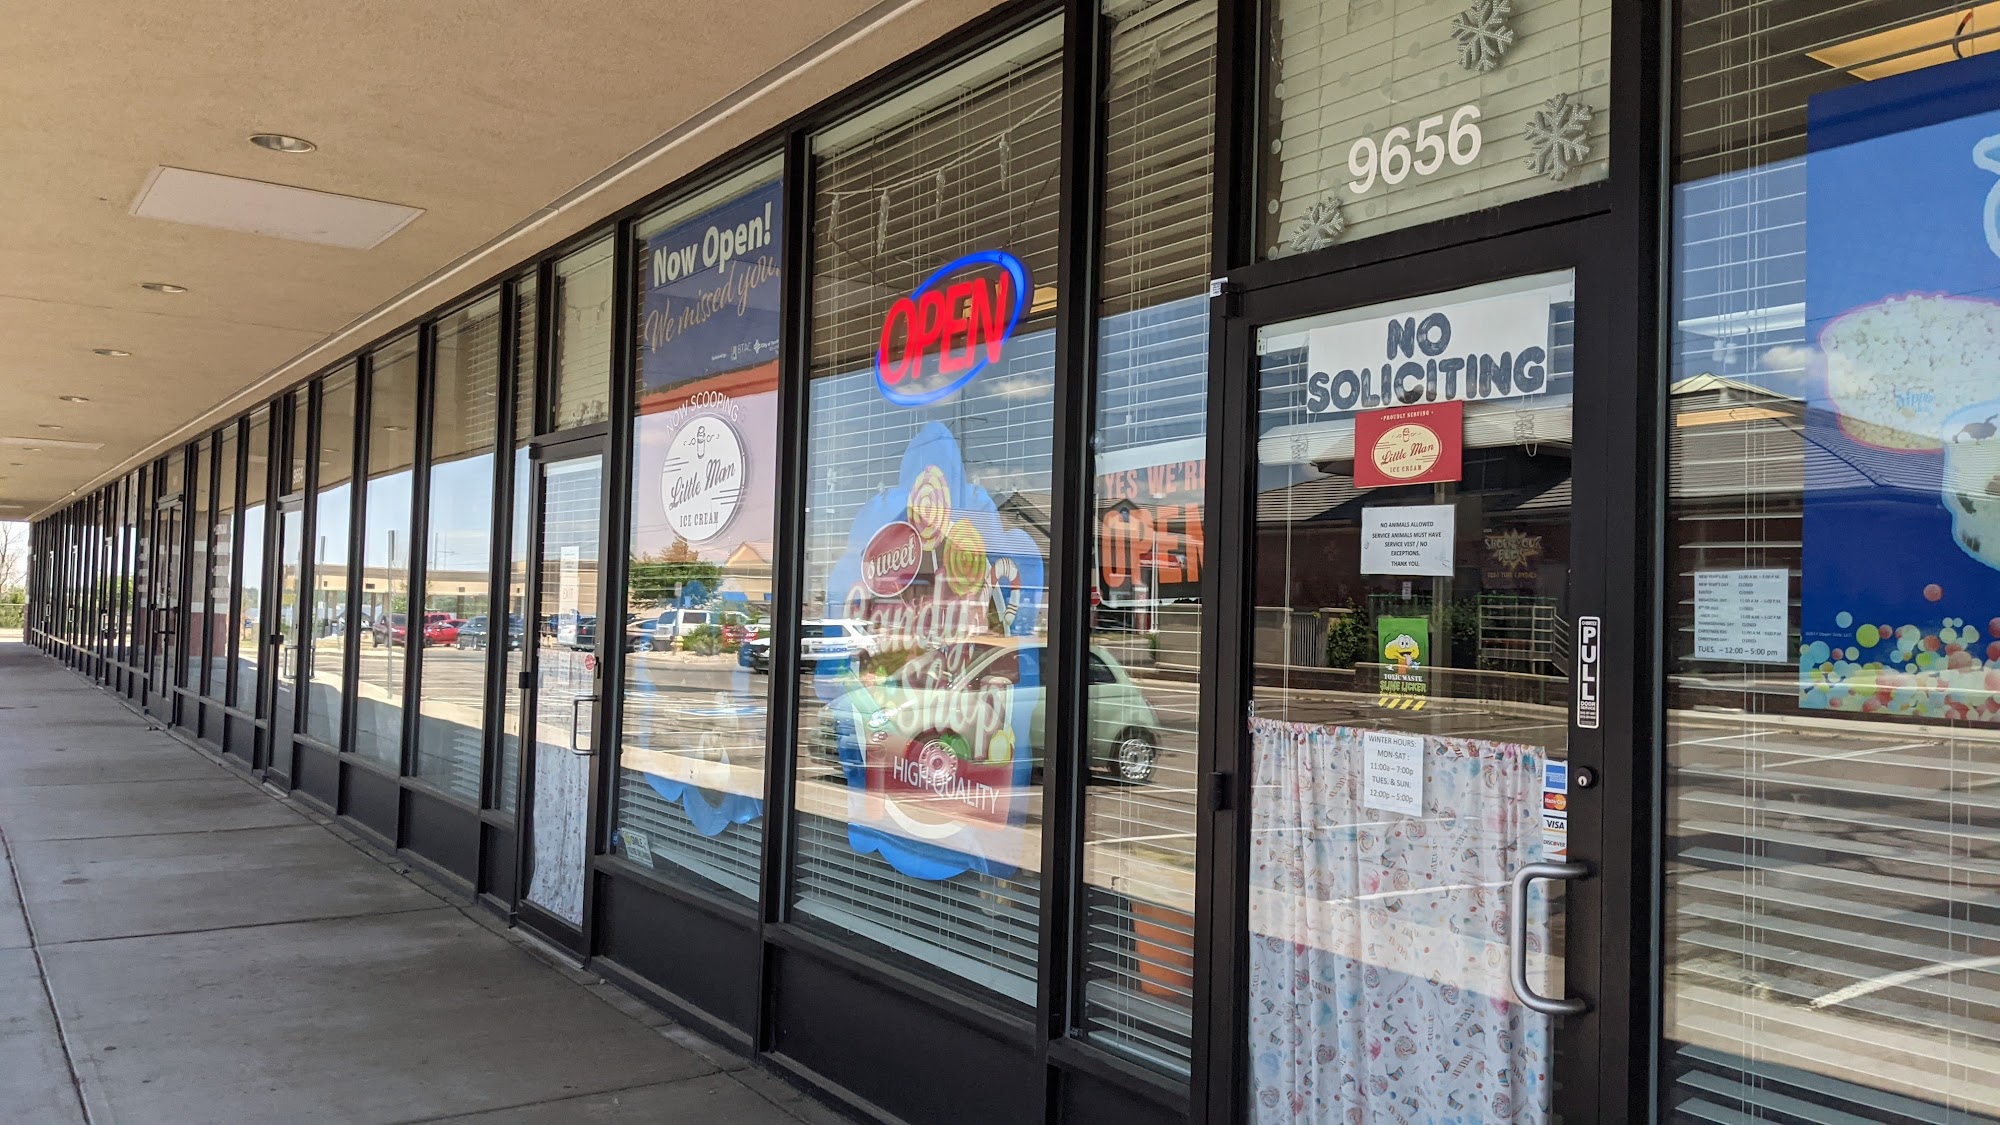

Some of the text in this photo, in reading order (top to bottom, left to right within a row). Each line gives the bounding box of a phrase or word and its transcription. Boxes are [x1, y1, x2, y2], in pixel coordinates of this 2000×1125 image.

[1348, 104, 1482, 194] 9656
[653, 201, 772, 288] Now Open!
[643, 298, 674, 354] We
[677, 260, 737, 336] missed
[879, 270, 1010, 386] OPEN
[1386, 312, 1452, 361] NO
[1306, 345, 1546, 414] SOLICITING
[665, 390, 740, 437] NOW SCOOPING
[1382, 410, 1430, 421] PROUDLY SERVING
[1380, 442, 1435, 466] Little Man
[1401, 464, 1422, 472] CREAM
[668, 458, 736, 511] Little Man
[1105, 468, 1138, 500] YES
[680, 511, 719, 528] ICE CREAM
[867, 533, 917, 580] sweet
[1101, 502, 1205, 588] OPEN
[843, 572, 974, 671] Candy
[1402, 674, 1423, 682] WASTE
[1581, 626, 1597, 701] PULL
[1379, 680, 1427, 693] SLIME LICKER
[897, 656, 1001, 758] Shop
[1368, 735, 1417, 748] WINTER HOURS:
[1377, 749, 1406, 760] MON-SAT
[893, 755, 1000, 814] HIGH QUALITY
[1370, 762, 1390, 771] 11:00a
[1396, 765, 1414, 776] 7:00p
[1371, 776, 1412, 788] TUES. & SUN.
[1369, 789, 1390, 800] 12:00p
[1396, 793, 1414, 804] 5:00p
[1543, 839, 1566, 848] DISCOVER
[1546, 819, 1565, 830] VISA
